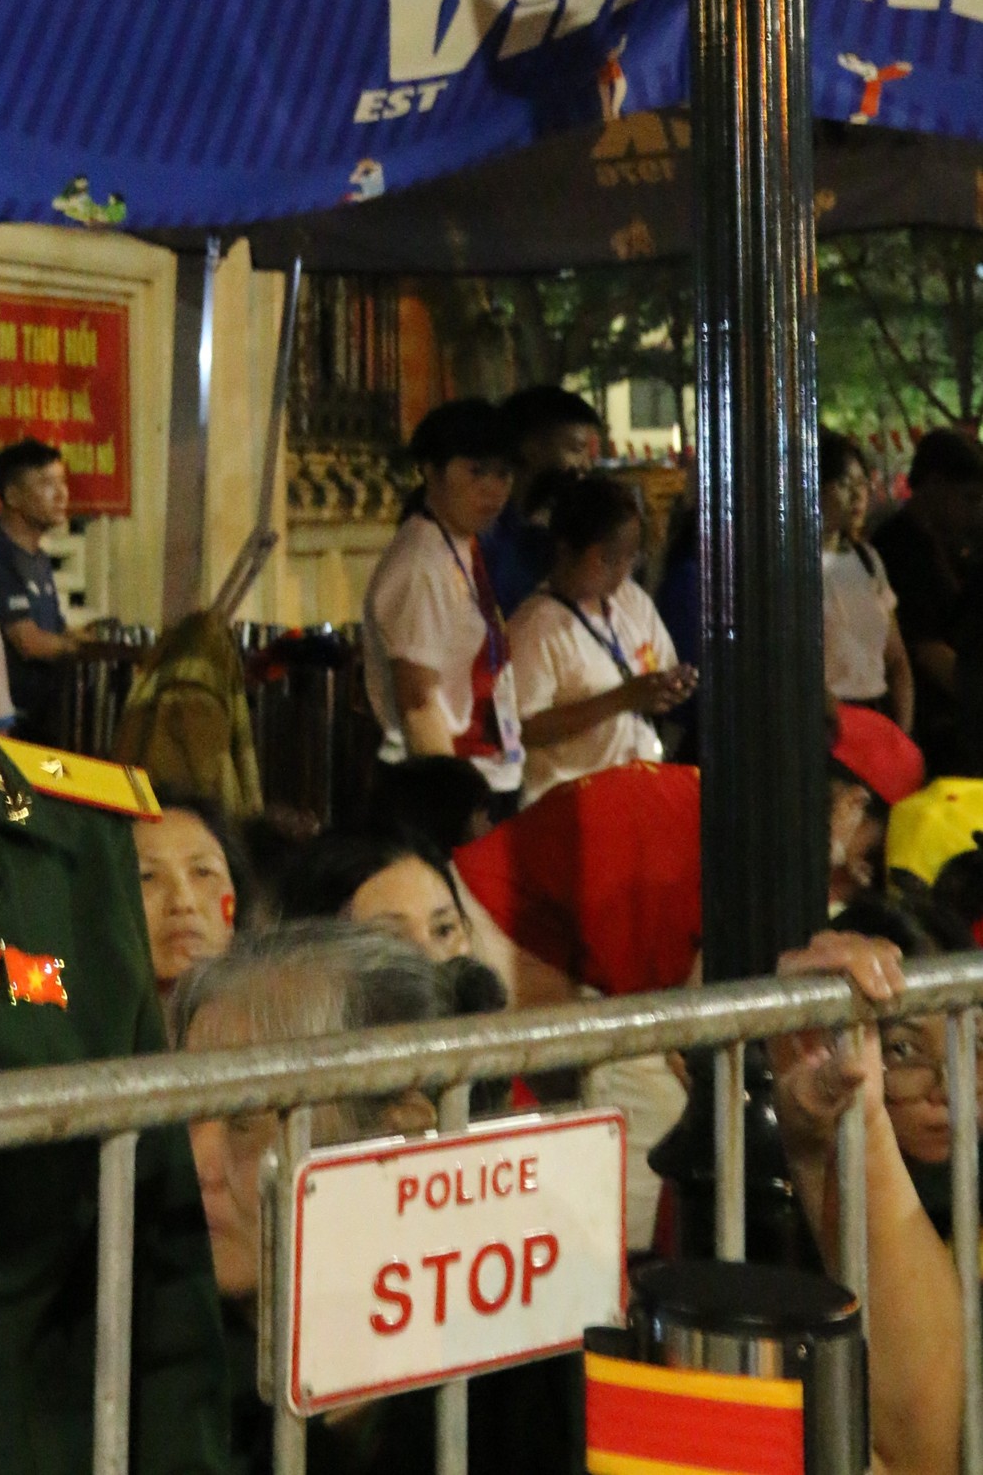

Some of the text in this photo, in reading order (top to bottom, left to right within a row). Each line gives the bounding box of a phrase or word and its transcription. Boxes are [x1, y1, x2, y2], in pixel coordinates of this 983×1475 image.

[353, 78, 449, 124] EST
[397, 1156, 539, 1216] POLICE
[370, 1228, 560, 1336] STOP
